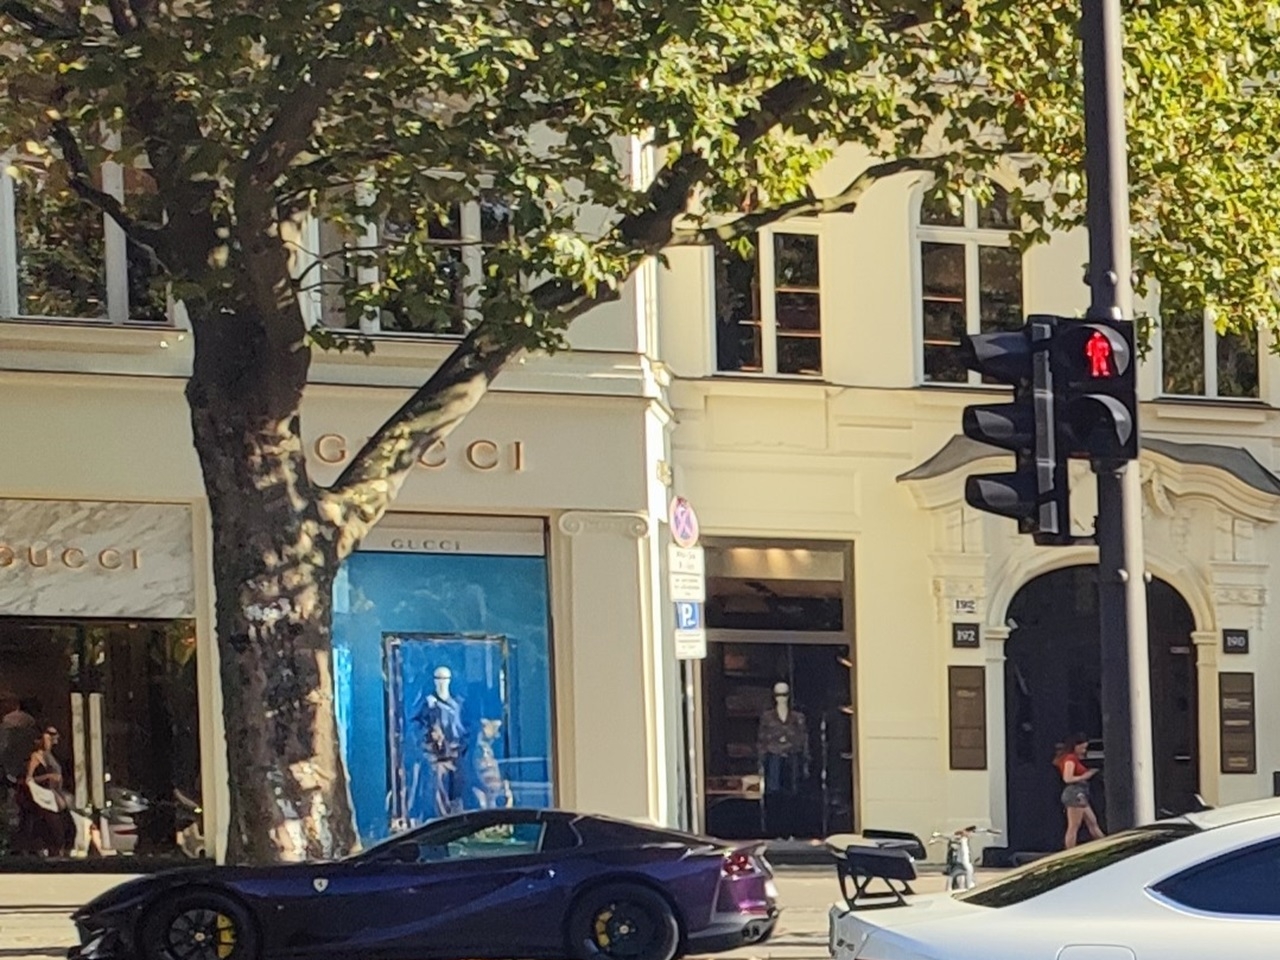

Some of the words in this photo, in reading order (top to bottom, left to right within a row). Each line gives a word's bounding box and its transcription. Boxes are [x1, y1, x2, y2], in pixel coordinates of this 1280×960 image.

[314, 433, 523, 471] GCCI
[391, 538, 461, 551] GUCCI
[956, 630, 976, 641] 192
[1226, 636, 1246, 647] 190
